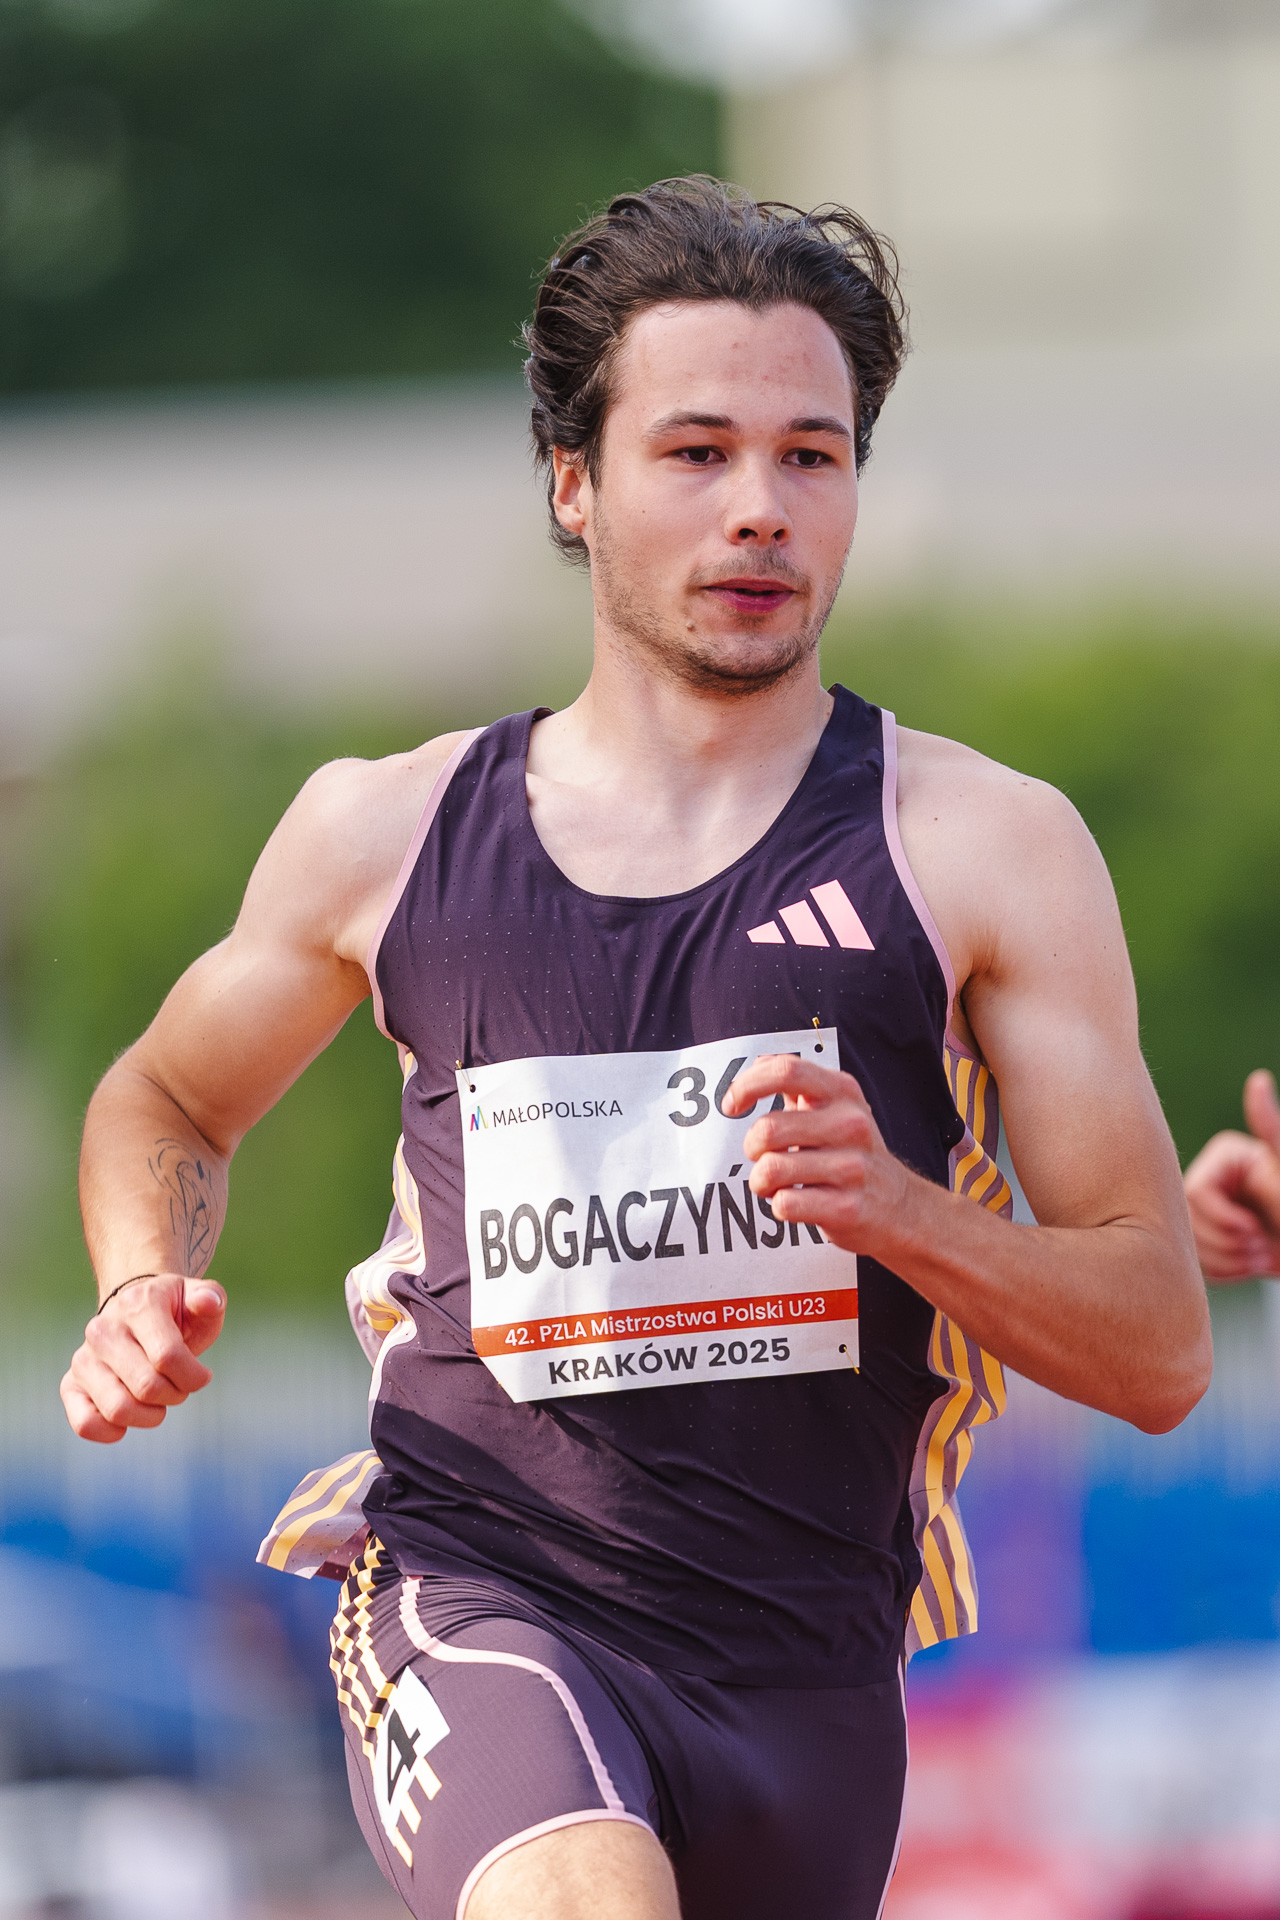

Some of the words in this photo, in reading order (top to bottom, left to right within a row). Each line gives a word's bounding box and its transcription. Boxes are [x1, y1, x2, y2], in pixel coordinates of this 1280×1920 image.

[493, 1100, 623, 1128] MAŁOPOLSKA
[480, 1164, 833, 1280] BOGACZYŃS
[504, 1327, 535, 1347] 42.
[540, 1321, 588, 1343] PZLA
[591, 1309, 717, 1337] Mistrzostwa
[722, 1299, 784, 1323] Polski
[789, 1296, 826, 1316] U23
[548, 1342, 698, 1385] KRAKÓW
[707, 1337, 791, 1368] 2025
[387, 1708, 421, 1806] 4
